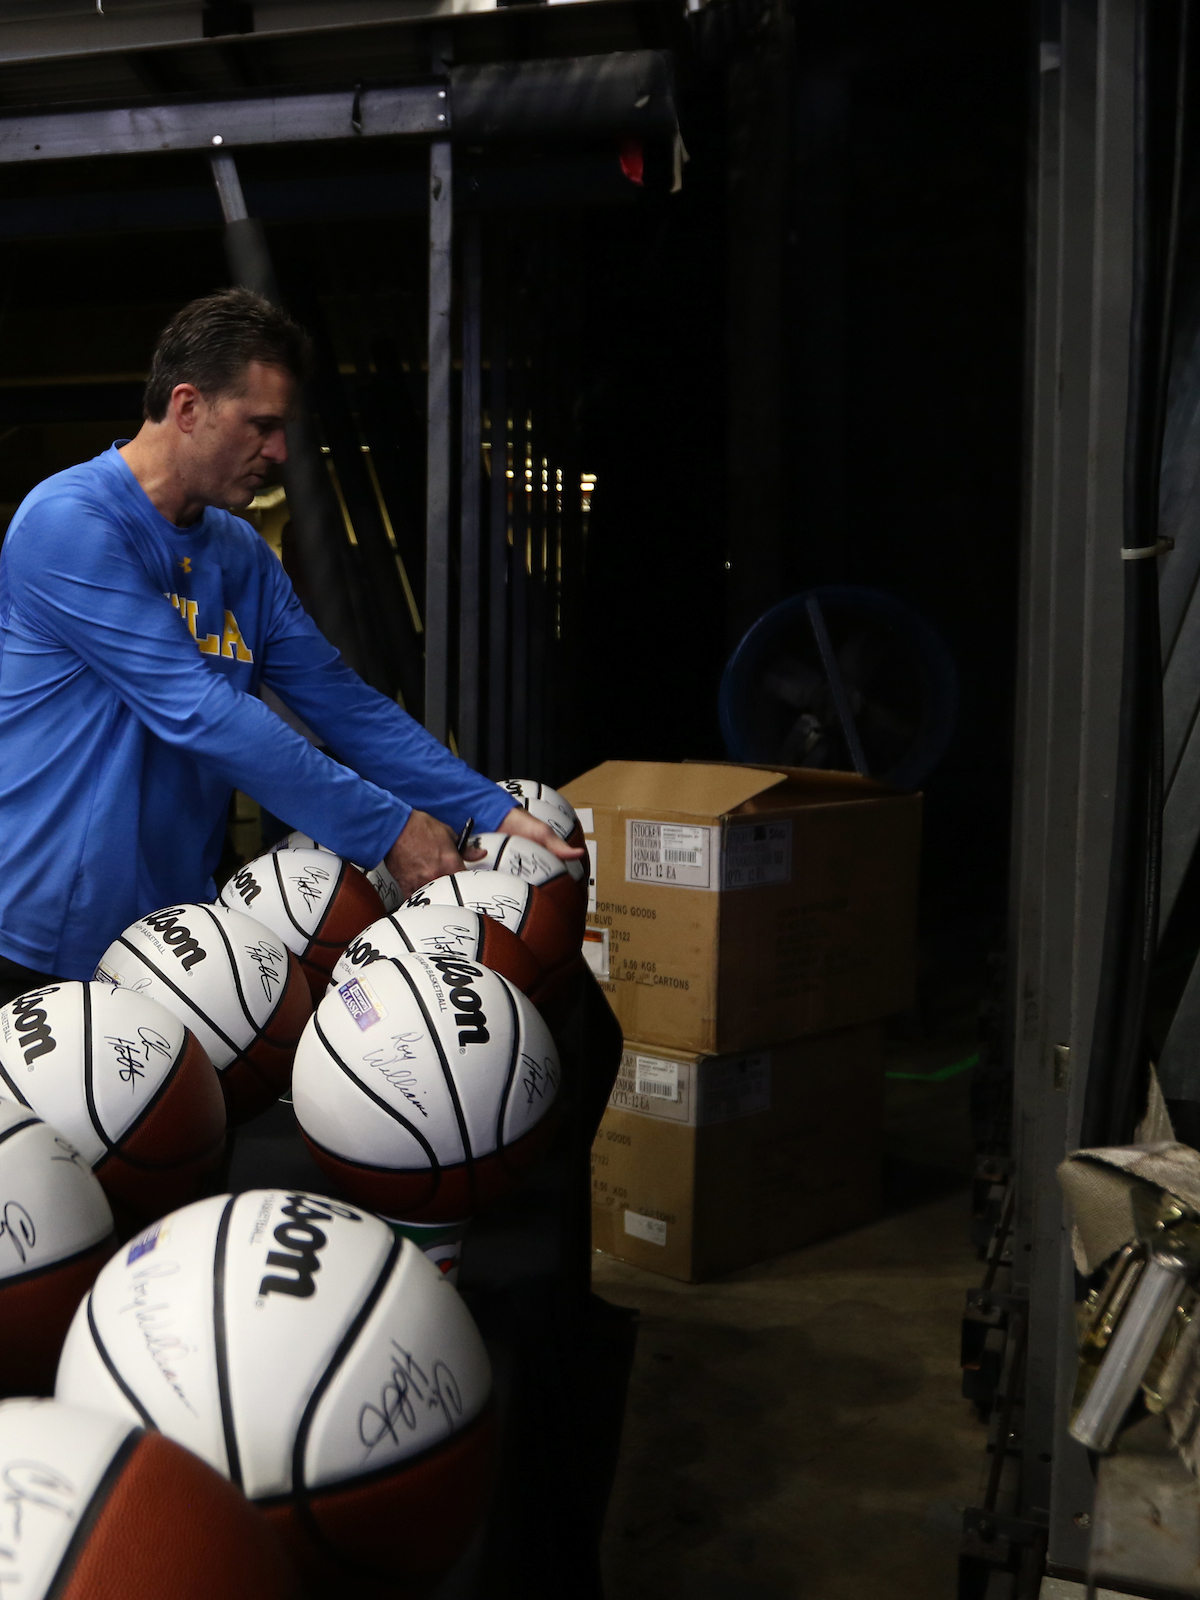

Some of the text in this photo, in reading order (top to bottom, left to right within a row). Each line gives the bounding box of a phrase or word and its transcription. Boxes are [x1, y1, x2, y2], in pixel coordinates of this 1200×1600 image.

[656, 864, 662, 877] 12
[666, 865, 676, 879] EA
[595, 914, 612, 926] BLVD
[631, 906, 656, 920] GOODS
[142, 929, 166, 955] BASKETBALL
[611, 929, 630, 942] 37122
[641, 961, 656, 973] KGS
[626, 971, 635, 981] OF
[653, 975, 690, 990] CARTONS
[426, 969, 448, 1012] BASKETBALL
[341, 991, 363, 1019] CLASSIC
